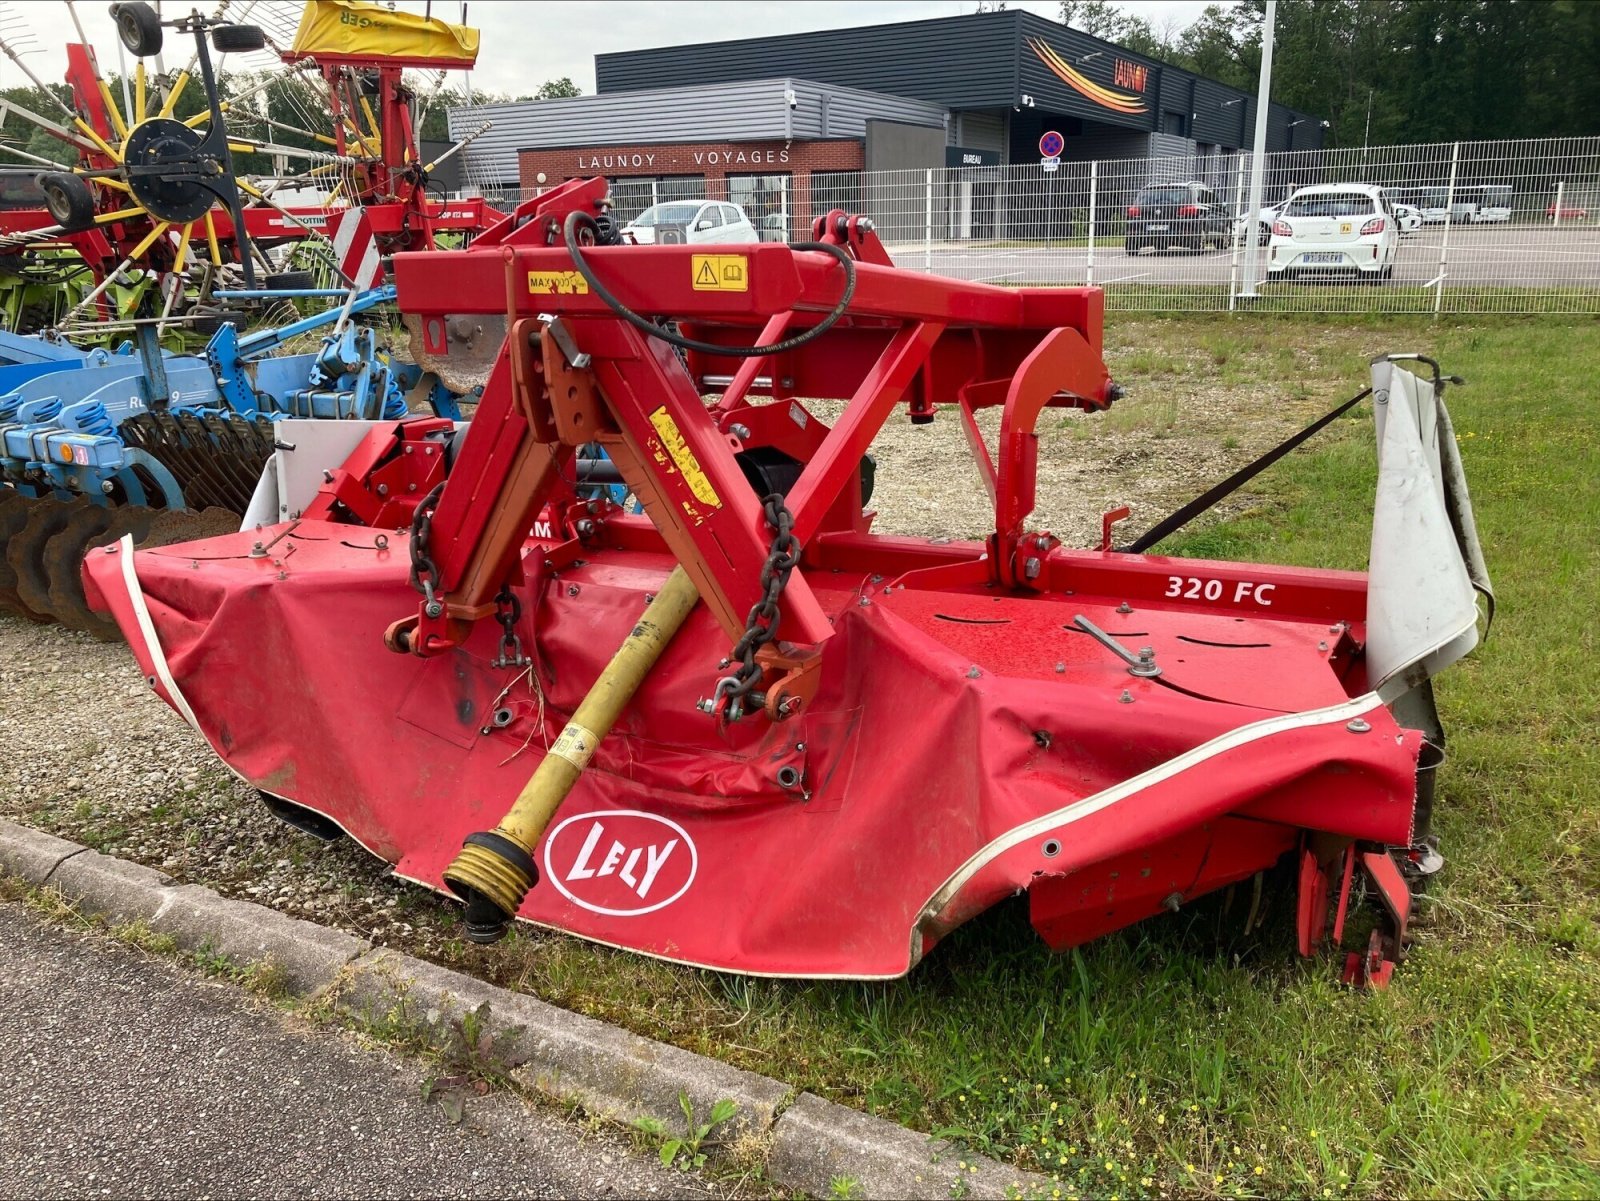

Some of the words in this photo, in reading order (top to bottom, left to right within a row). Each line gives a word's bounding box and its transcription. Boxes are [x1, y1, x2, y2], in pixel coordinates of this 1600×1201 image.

[1114, 57, 1149, 93] LAUNOY
[579, 154, 655, 169] LAUNOY
[694, 150, 789, 165] VOYAGES
[962, 153, 982, 165] BUREAU
[1164, 576, 1223, 601] 320
[1233, 582, 1276, 605] FC
